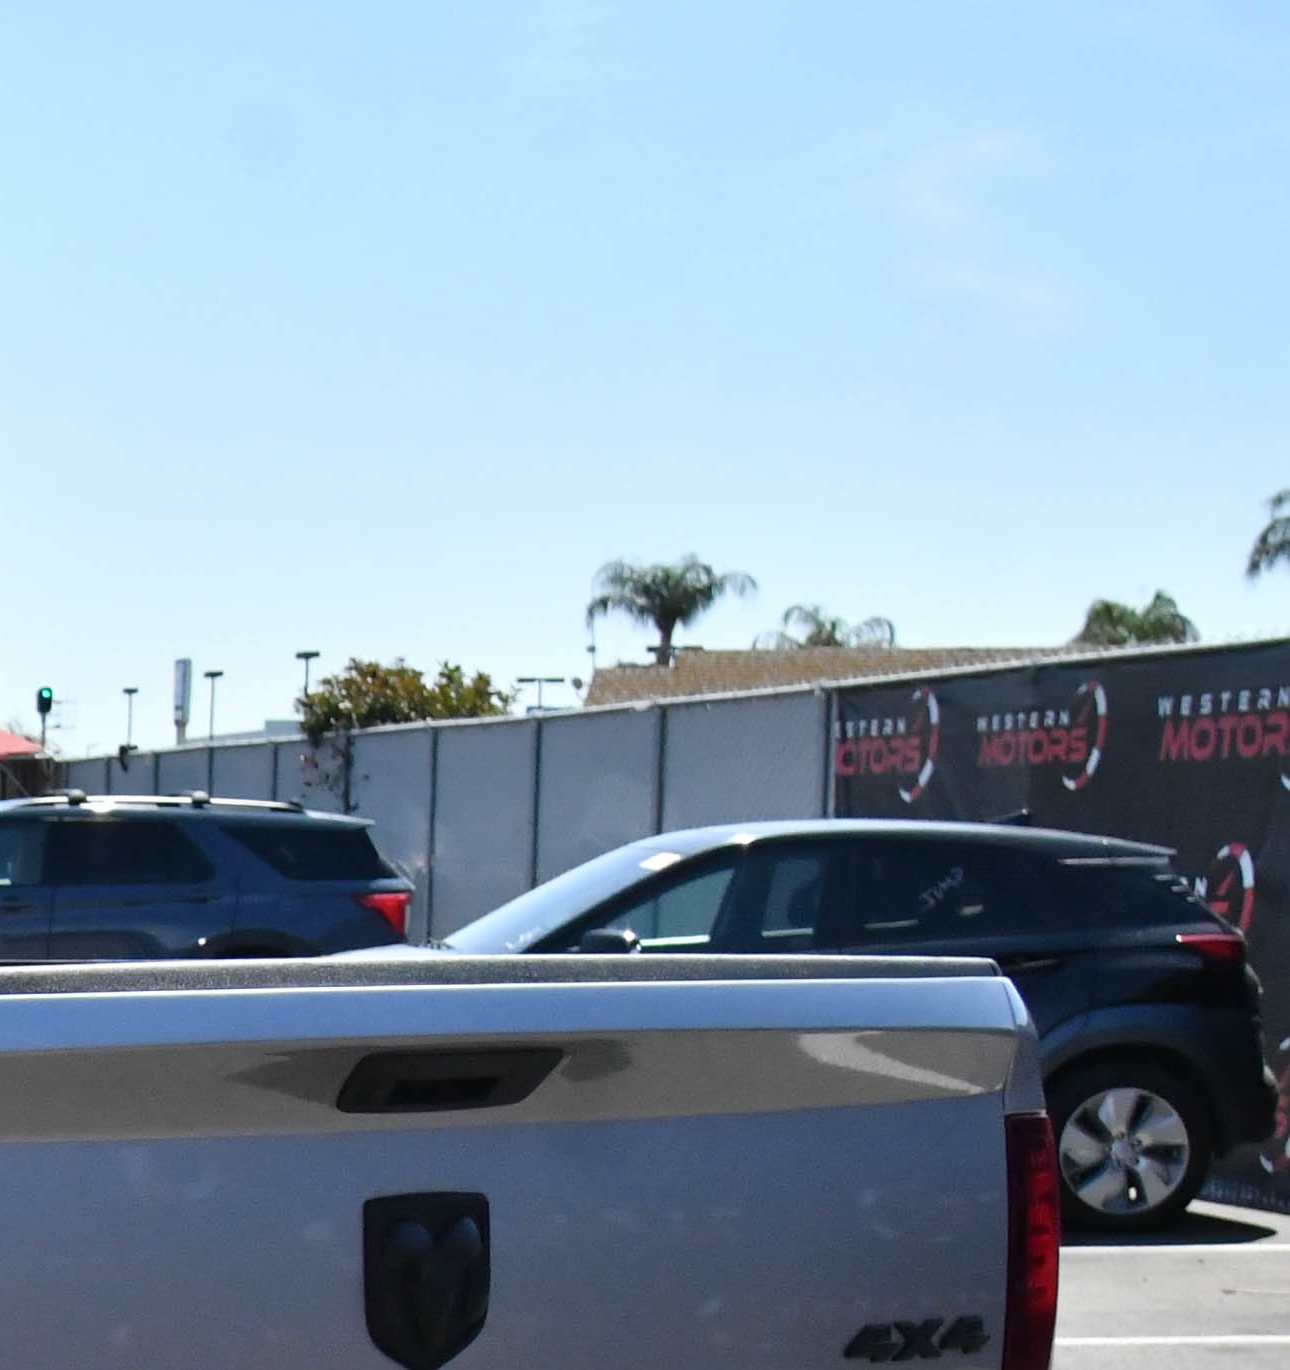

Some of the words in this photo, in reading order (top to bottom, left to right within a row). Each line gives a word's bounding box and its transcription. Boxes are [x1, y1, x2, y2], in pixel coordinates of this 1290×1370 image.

[977, 709, 1070, 732] WESTERN
[1157, 686, 1290, 717] WESTERN
[977, 728, 1088, 767] MOTORS
[1159, 710, 1290, 762] MOTOR
[836, 737, 920, 775] OTORS
